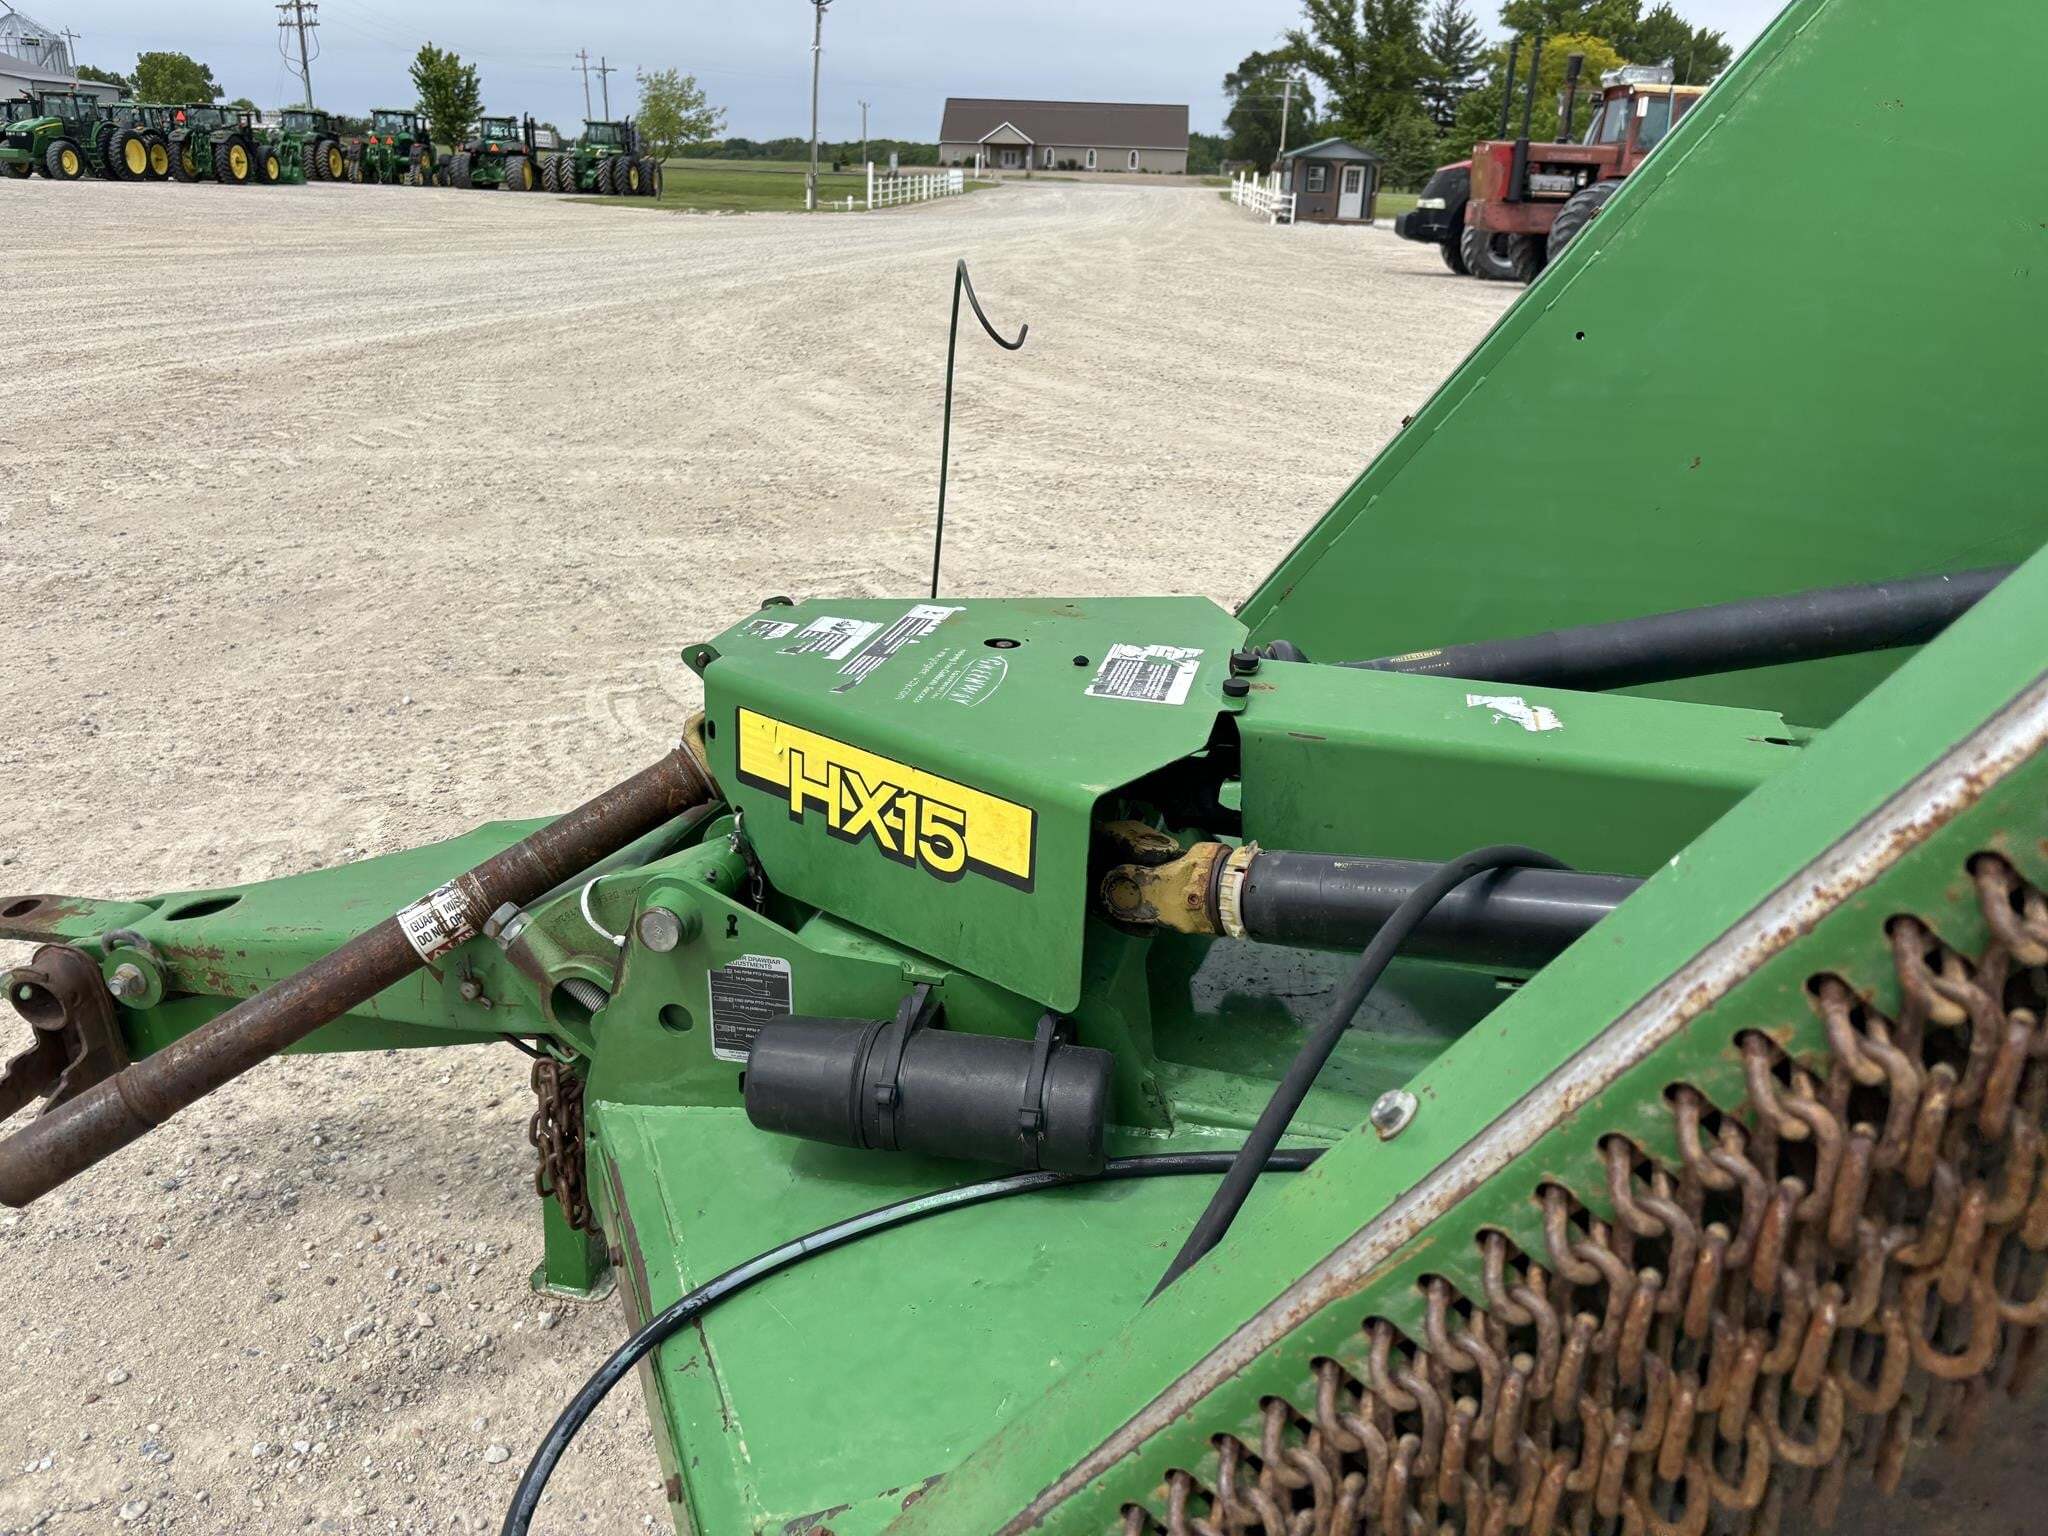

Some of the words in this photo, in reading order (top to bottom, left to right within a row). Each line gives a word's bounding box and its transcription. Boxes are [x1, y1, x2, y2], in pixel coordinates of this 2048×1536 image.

[788, 747, 969, 882] HX15
[416, 931, 433, 946] DO
[747, 956, 781, 965] DRAWBAR
